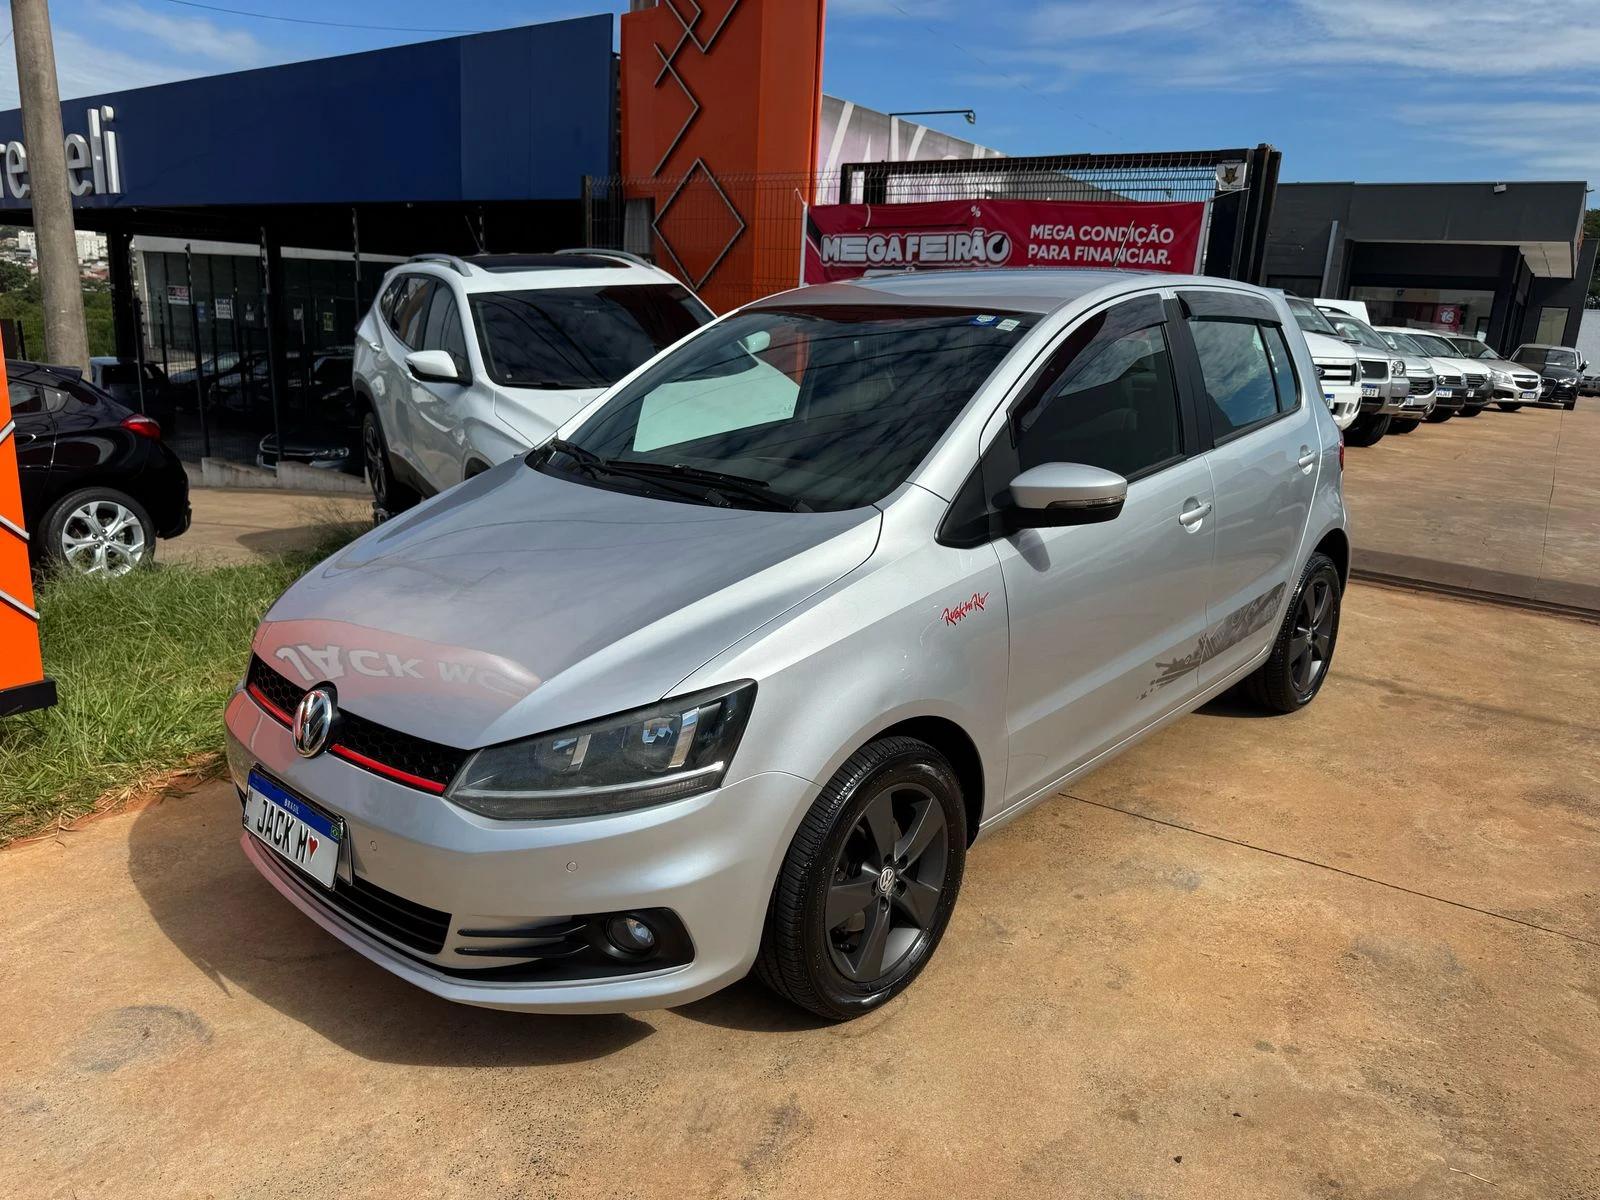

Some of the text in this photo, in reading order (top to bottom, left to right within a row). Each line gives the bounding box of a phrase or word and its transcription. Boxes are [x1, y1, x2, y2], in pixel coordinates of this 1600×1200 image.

[821, 230, 1010, 263] MEGA FEIRÃO
[1030, 224, 1174, 247] MEGA CONDIÇÃO
[1028, 244, 1171, 265] PARA FINANCIAR.
[257, 798, 311, 864] JACK M
